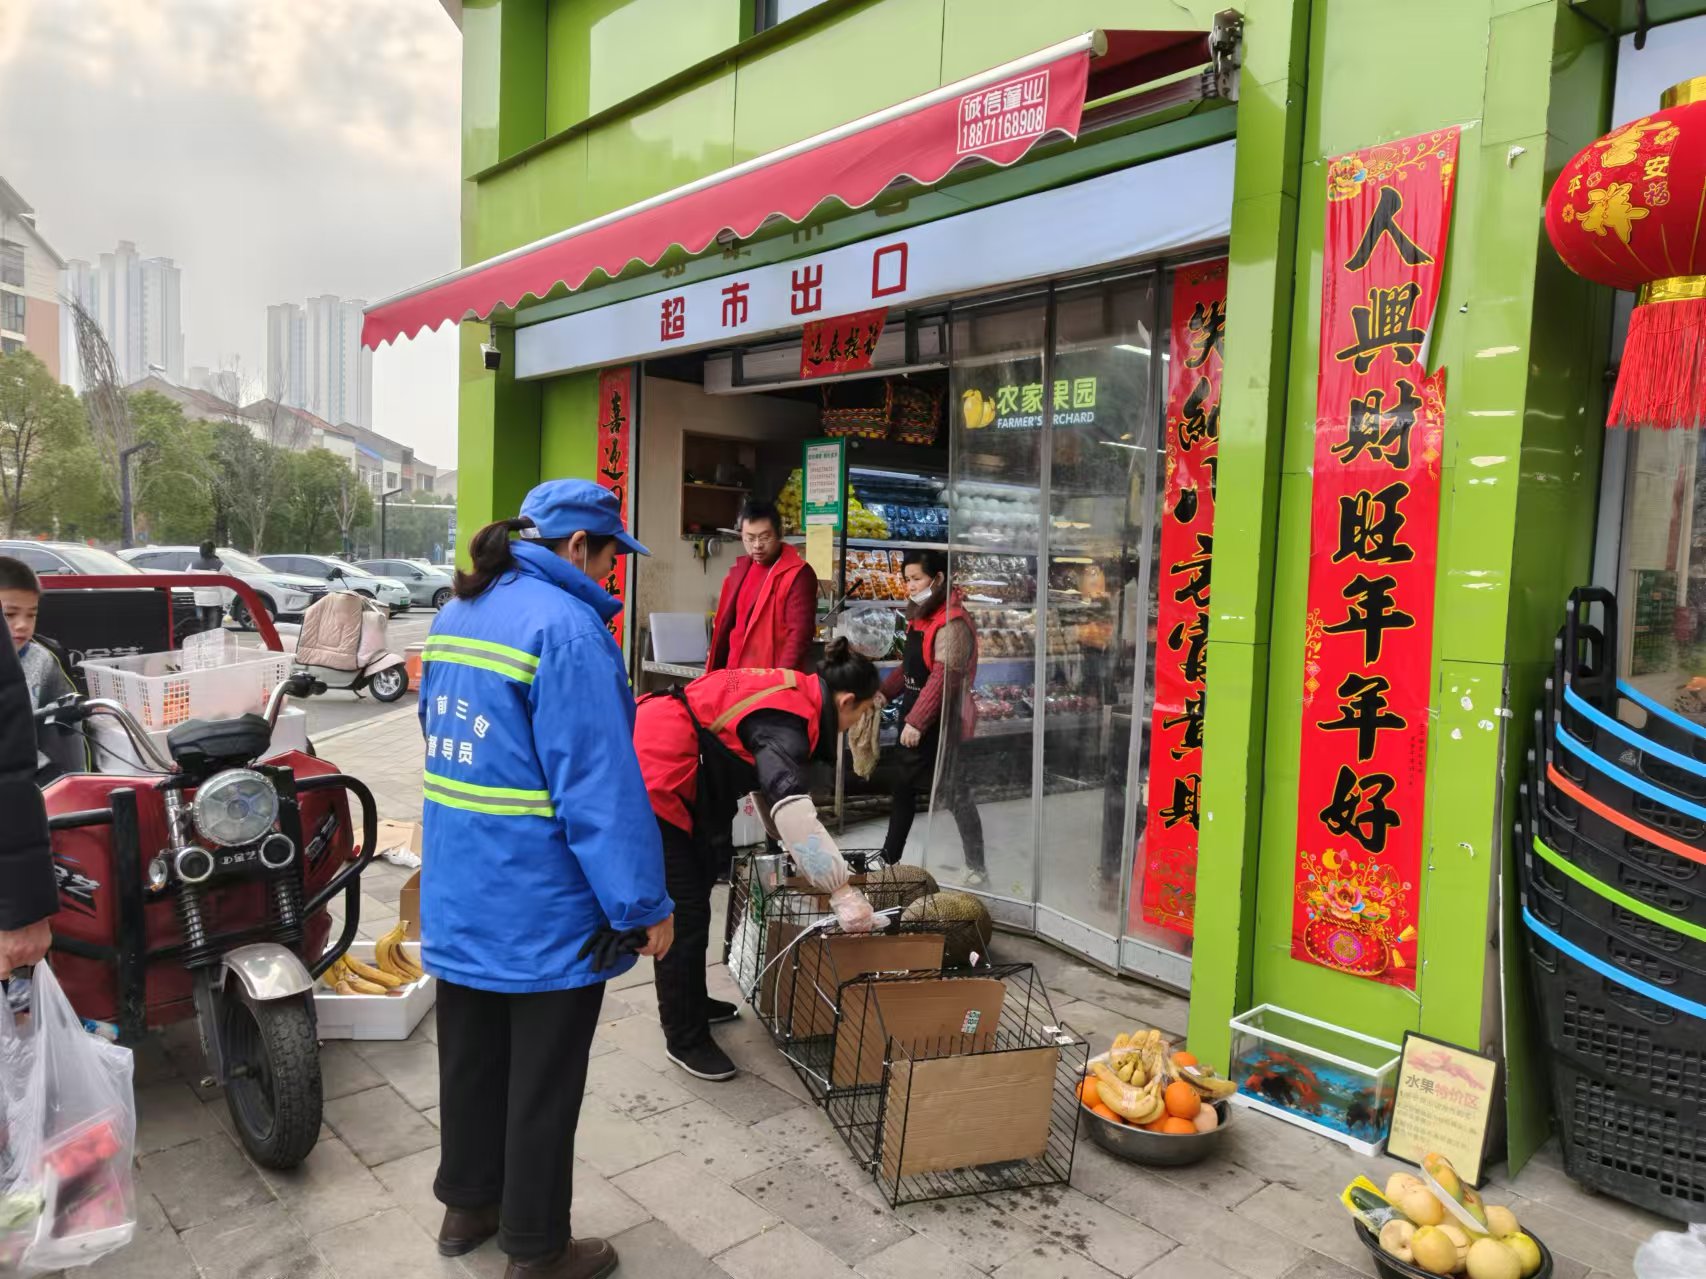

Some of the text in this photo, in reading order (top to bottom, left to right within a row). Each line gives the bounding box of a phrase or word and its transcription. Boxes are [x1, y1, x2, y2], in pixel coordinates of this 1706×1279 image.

[963, 106, 1044, 149] 18871168908
[1642, 156, 1670, 181] 安
[661, 242, 908, 341] 超市出口
[997, 377, 1096, 415] 农家果园
[997, 411, 1095, 429] FARMER'S RCHARD
[1405, 1074, 1480, 1108] 水果特价区
